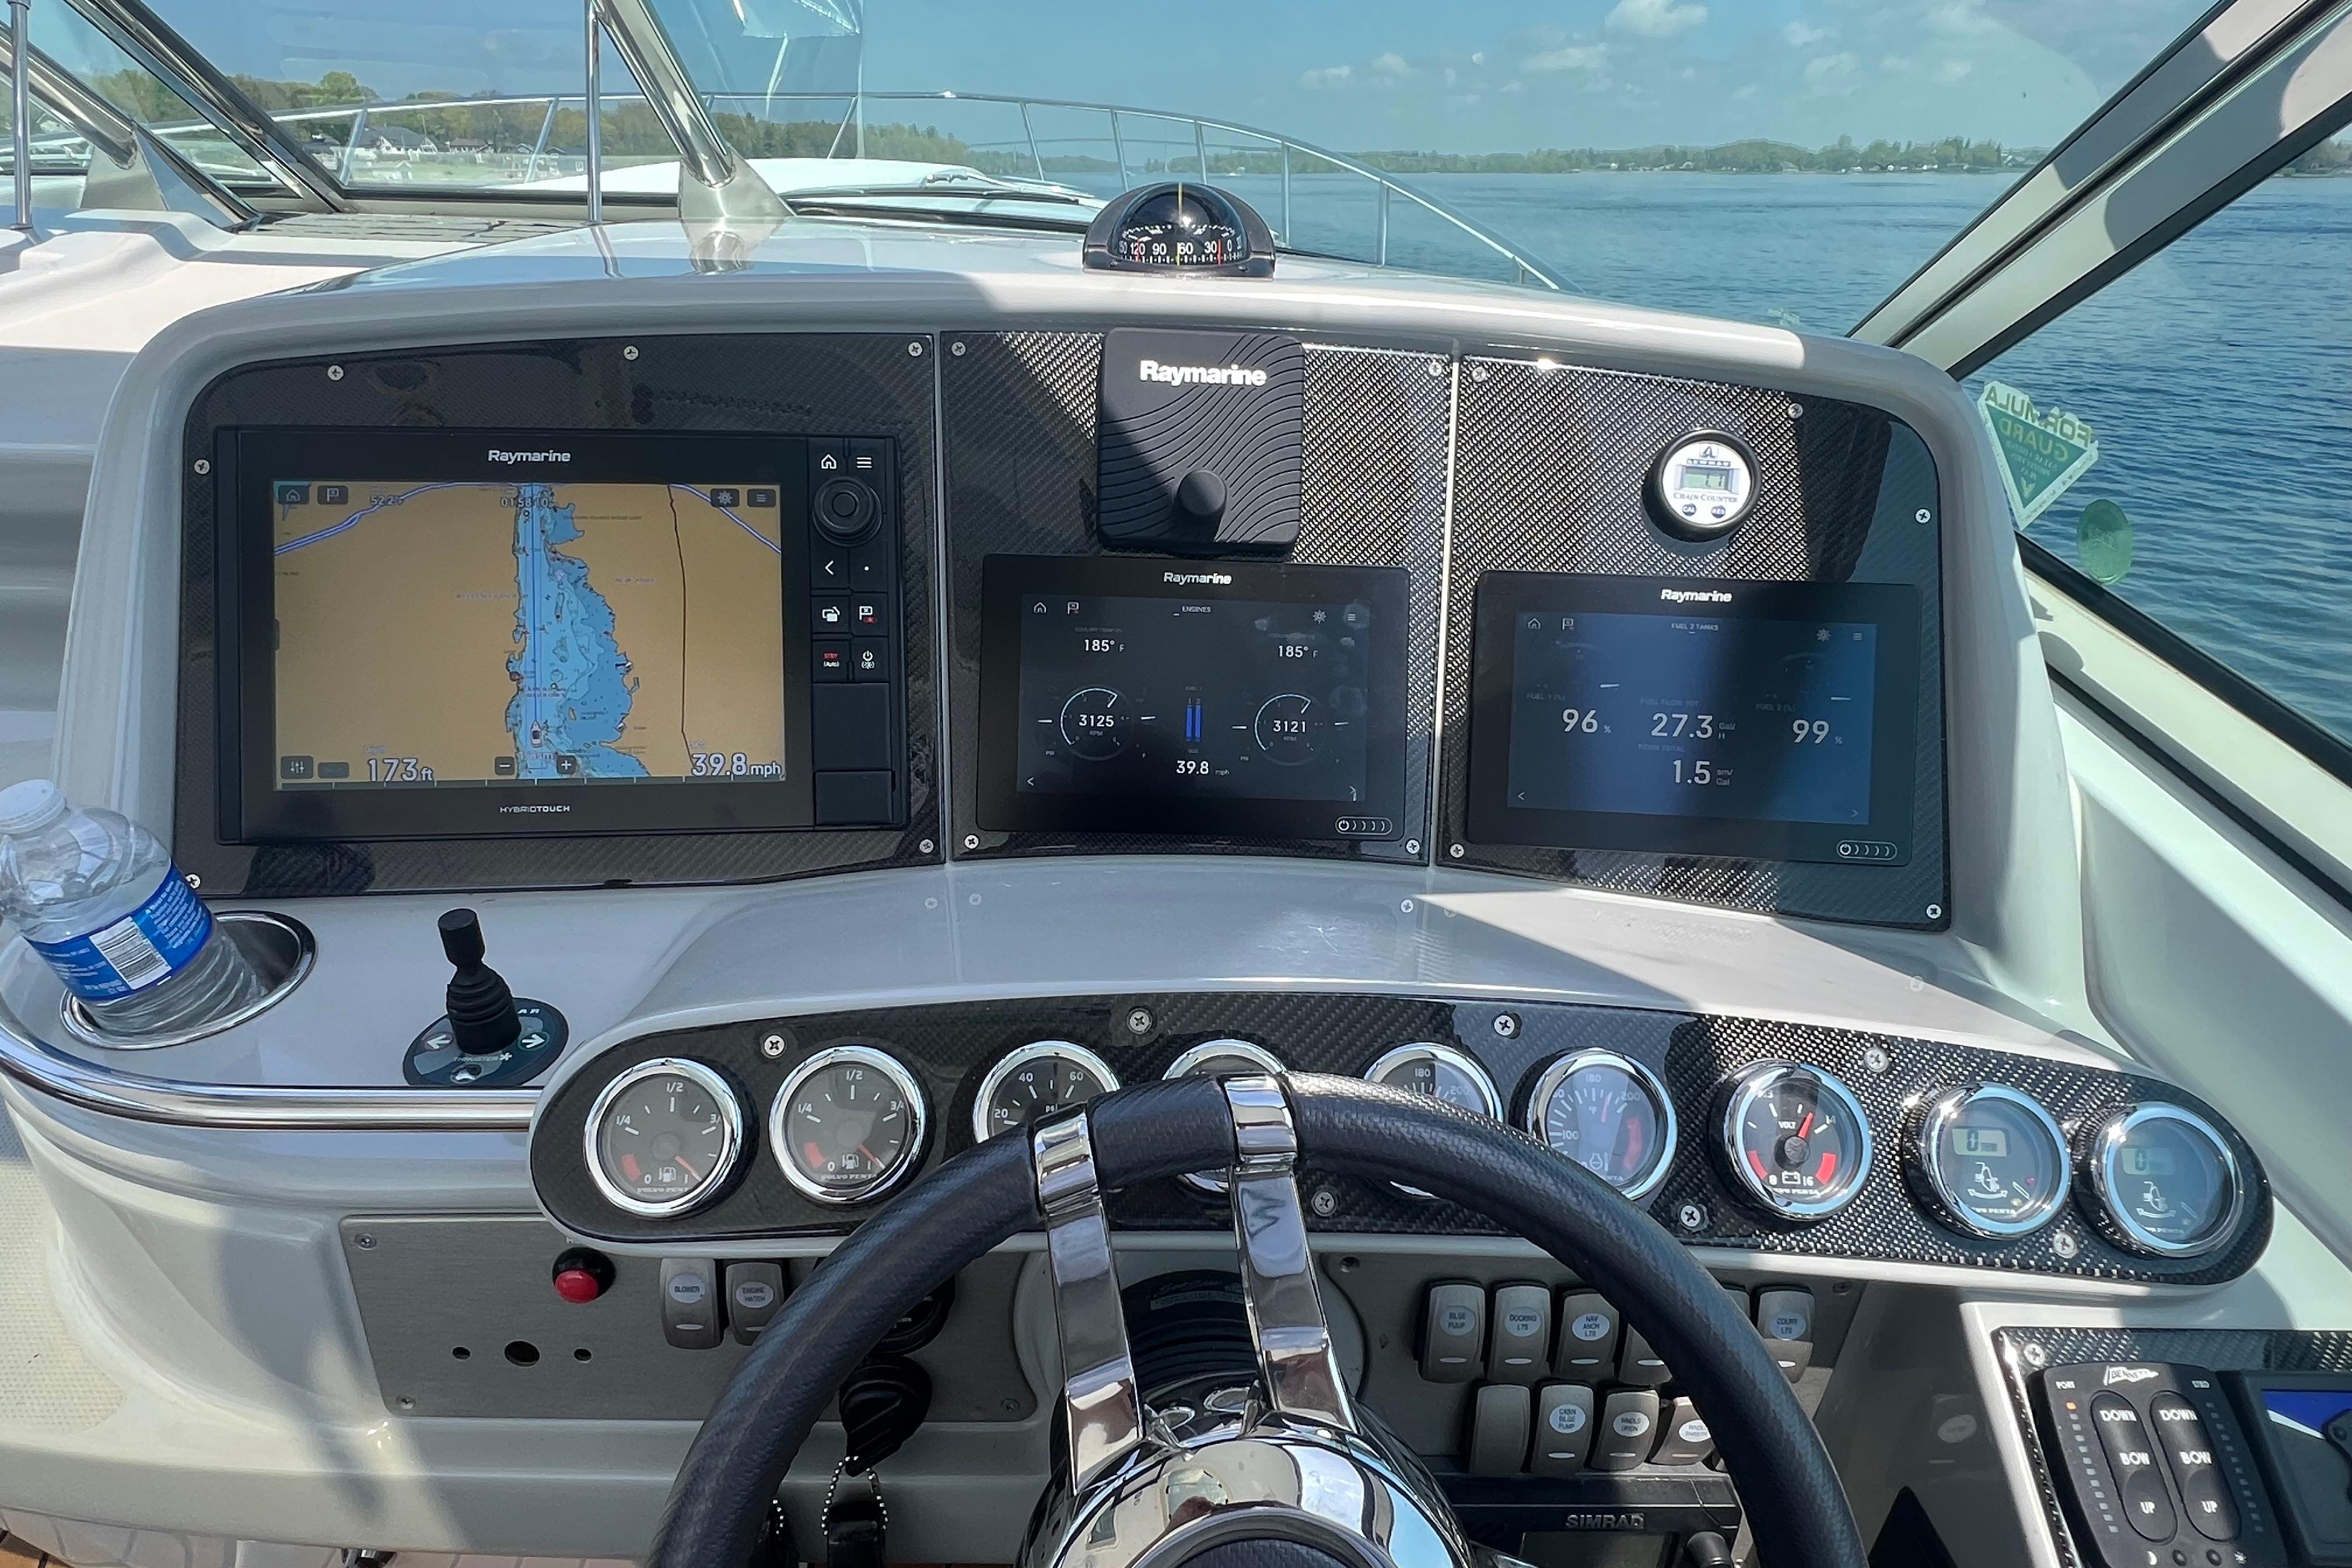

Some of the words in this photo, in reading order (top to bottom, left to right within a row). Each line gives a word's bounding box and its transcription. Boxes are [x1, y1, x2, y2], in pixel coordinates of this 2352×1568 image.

[1130, 243, 1146, 255] 120
[1152, 243, 1167, 256] 90
[1179, 242, 1194, 254] 60
[1204, 241, 1217, 253] 30
[1227, 239, 1233, 252] 0
[1140, 360, 1267, 386] Raymarine
[488, 449, 571, 465] Raymarine
[1163, 572, 1232, 586] Raymarine
[1660, 589, 1732, 603] Raymarine
[1079, 714, 1114, 727] 3125
[1273, 720, 1307, 733] 3121
[1562, 708, 1598, 733] 96
[1604, 724, 1612, 734] %
[1651, 713, 1713, 739] 27.3
[1793, 719, 1830, 744] 99
[1835, 736, 1843, 744] %
[368, 758, 418, 782] 173
[420, 768, 435, 781] ft
[692, 753, 747, 776] 39.8
[750, 762, 781, 779] mph
[1176, 760, 1209, 775] 39.8
[1672, 760, 1710, 785] 1.5
[499, 805, 570, 814] HYBRIDTOUCH
[846, 1069, 863, 1081] 1/2
[1019, 1072, 1034, 1083] 40
[1069, 1071, 1084, 1082] 60
[1415, 1068, 1431, 1077] 180
[1586, 1073, 1602, 1083] 180
[666, 1082, 684, 1094] 1/2
[1450, 1085, 1469, 1096] 200
[1620, 1091, 1640, 1101] 200
[797, 1102, 813, 1114] 1/4
[994, 1108, 1009, 1118] 20
[1045, 1103, 1059, 1113] psi
[616, 1114, 631, 1126] 1/4
[709, 1114, 720, 1124] 3/
[1778, 1120, 1797, 1129] VOLT
[1562, 1129, 1579, 1140] 100
[827, 1161, 835, 1172] 0
[867, 1160, 872, 1170] 1
[644, 1174, 652, 1184] 0
[684, 1174, 688, 1184] 1
[1769, 1175, 1777, 1185] 8
[1803, 1176, 1814, 1186] 16
[1509, 1314, 1537, 1322] DOCKING
[1448, 1321, 1465, 1329] PUMP
[1517, 1323, 1528, 1331] LTS
[1780, 1326, 1793, 1335] LTS
[2100, 1409, 2137, 1422] DOWN
[2158, 1409, 2198, 1421] DOWN
[2119, 1451, 2151, 1466] BOW
[2179, 1451, 2213, 1464] BOW
[2140, 1501, 2157, 1514] UP
[2201, 1500, 2218, 1514] UP
